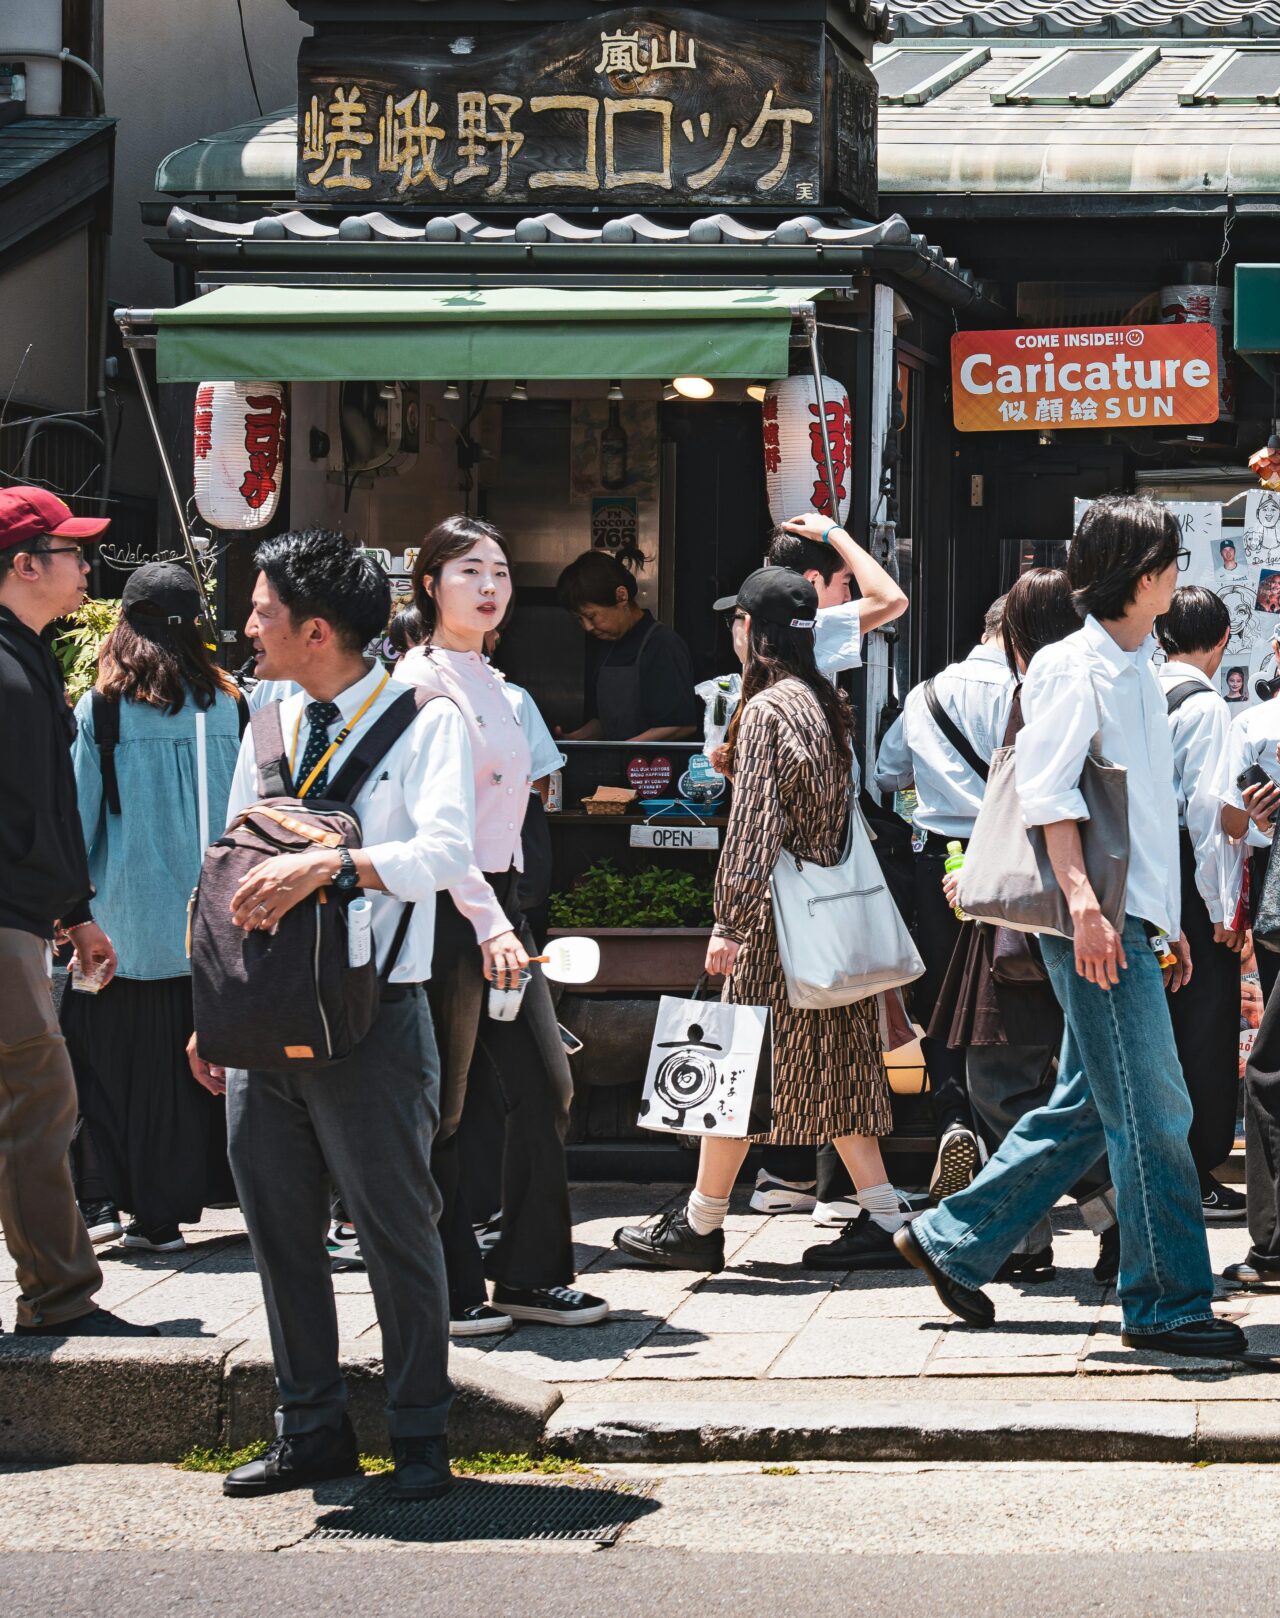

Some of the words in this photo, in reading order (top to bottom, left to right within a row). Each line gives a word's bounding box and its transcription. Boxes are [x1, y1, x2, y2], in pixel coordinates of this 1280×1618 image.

[595, 29, 697, 74] 嵐山
[303, 86, 813, 195] 嵯峨野コロッケ
[1015, 334, 1060, 348] COME
[1064, 332, 1124, 347] INSIDE!!
[960, 352, 1211, 395] Caricature
[593, 520, 636, 528] COCOLO
[593, 528, 637, 549] 765
[653, 830, 693, 847] OPEN
